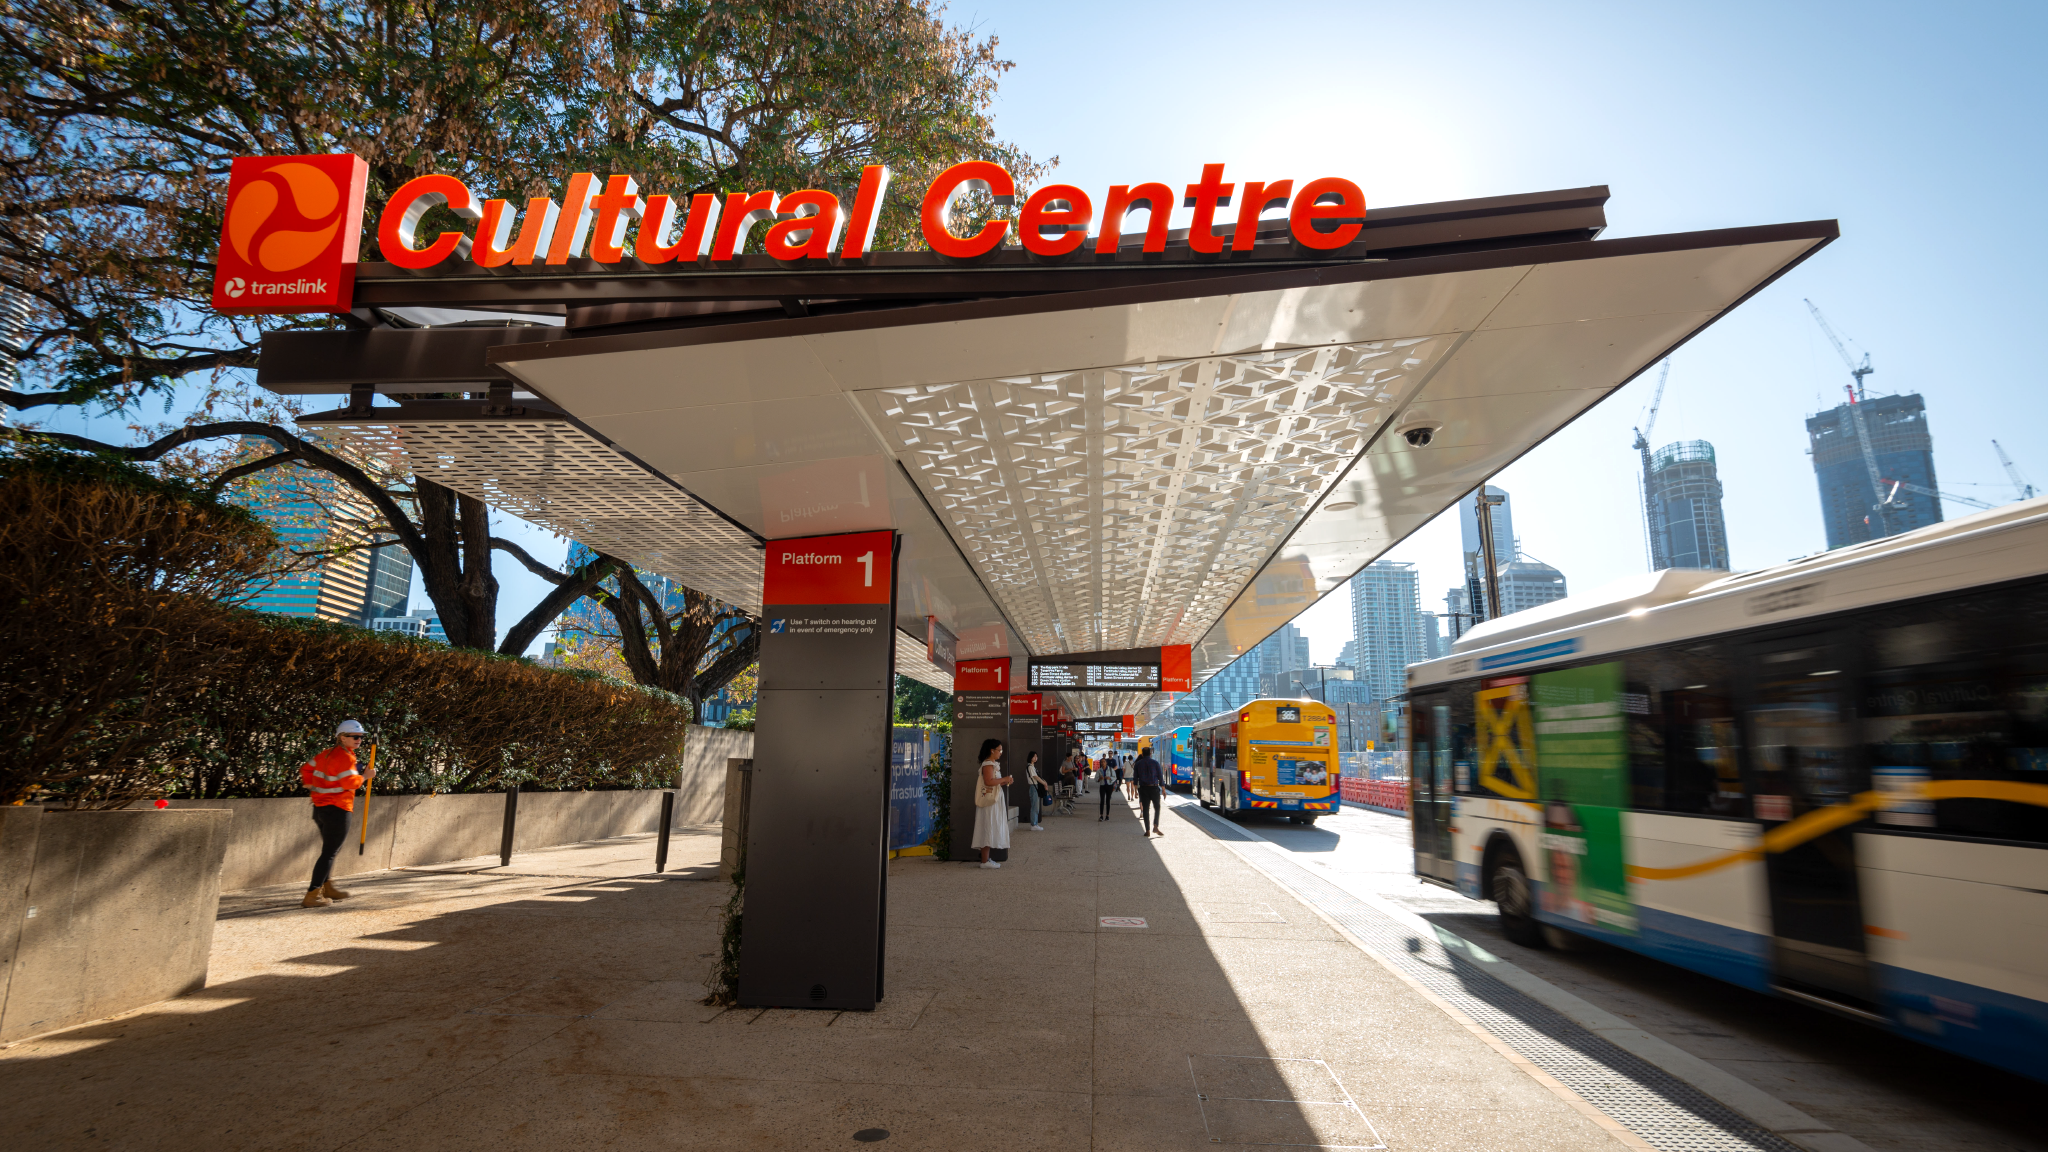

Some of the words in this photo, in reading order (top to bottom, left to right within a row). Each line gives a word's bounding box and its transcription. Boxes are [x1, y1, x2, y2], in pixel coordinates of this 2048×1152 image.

[379, 164, 891, 270] Cultural
[921, 160, 1367, 260] Centre
[251, 277, 328, 296] translink
[782, 552, 842, 565] Platform
[856, 551, 873, 587] 1
[841, 618, 866, 627] hearing
[823, 627, 859, 635] emergency
[860, 626, 874, 634] only
[935, 637, 947, 660] Cultural
[993, 666, 1002, 684] 1
[1184, 678, 1190, 689] 1
[1032, 698, 1038, 711] 1
[1050, 713, 1055, 723] 1
[893, 741, 904, 754] ew
